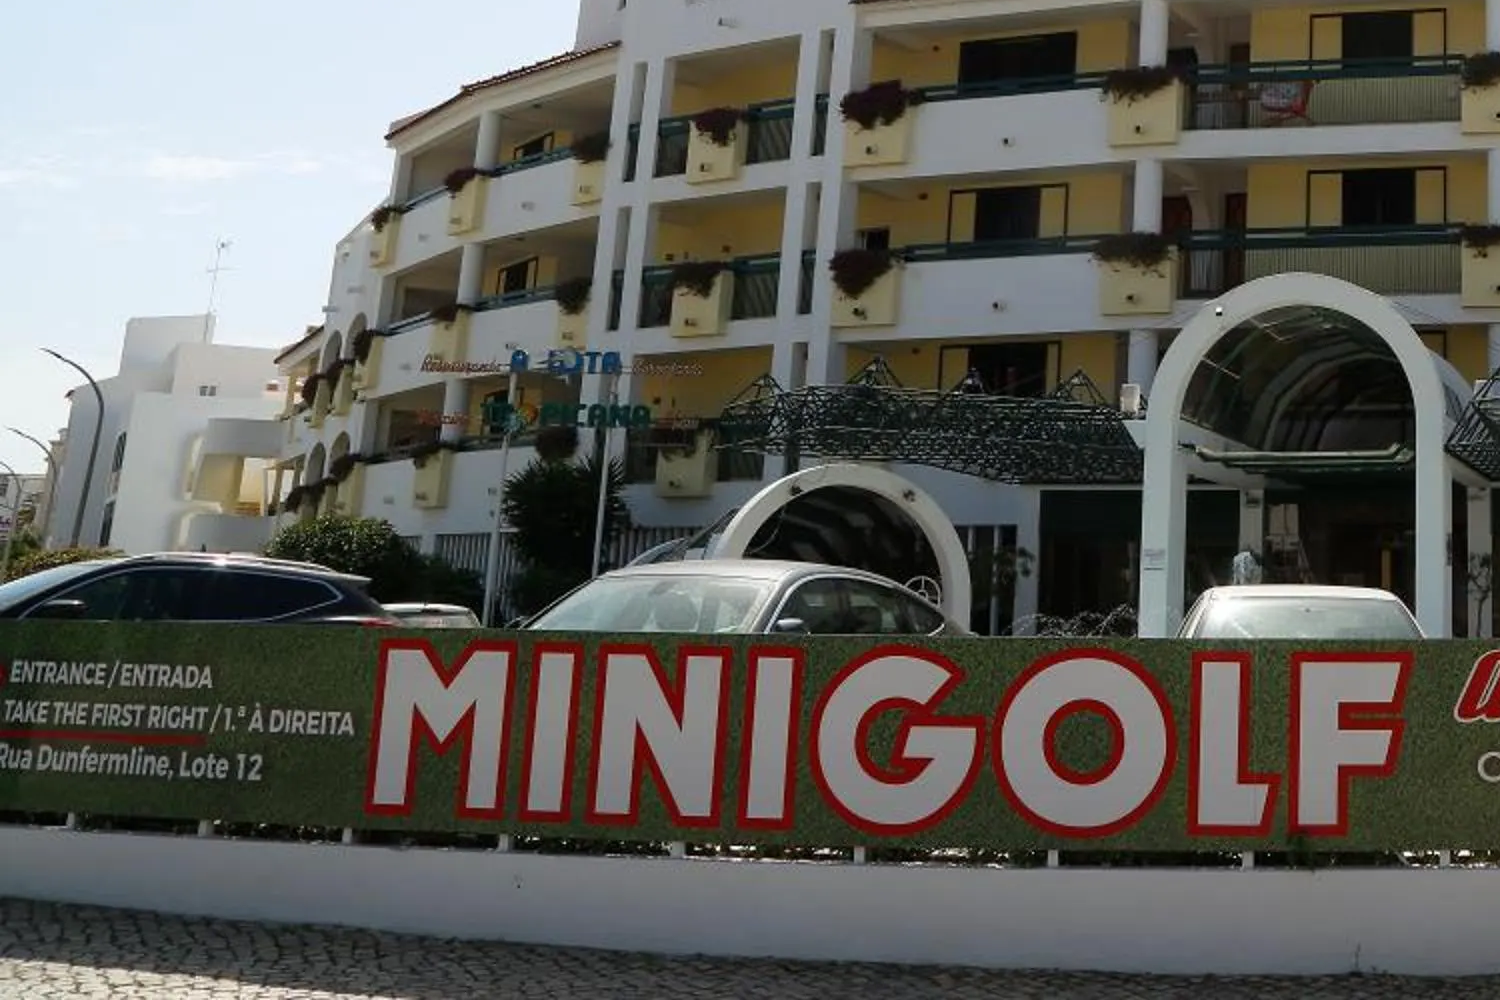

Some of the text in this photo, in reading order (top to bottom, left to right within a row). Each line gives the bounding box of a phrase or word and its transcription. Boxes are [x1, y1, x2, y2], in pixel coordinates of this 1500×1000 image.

[5, 699, 50, 724] TAKE
[53, 701, 89, 726] THE
[91, 702, 146, 729] FIRST
[269, 708, 355, 736] DIREITA
[364, 637, 1416, 839] MINIGOLF
[0, 742, 263, 782] Rua Dunfermline, Lote 12
